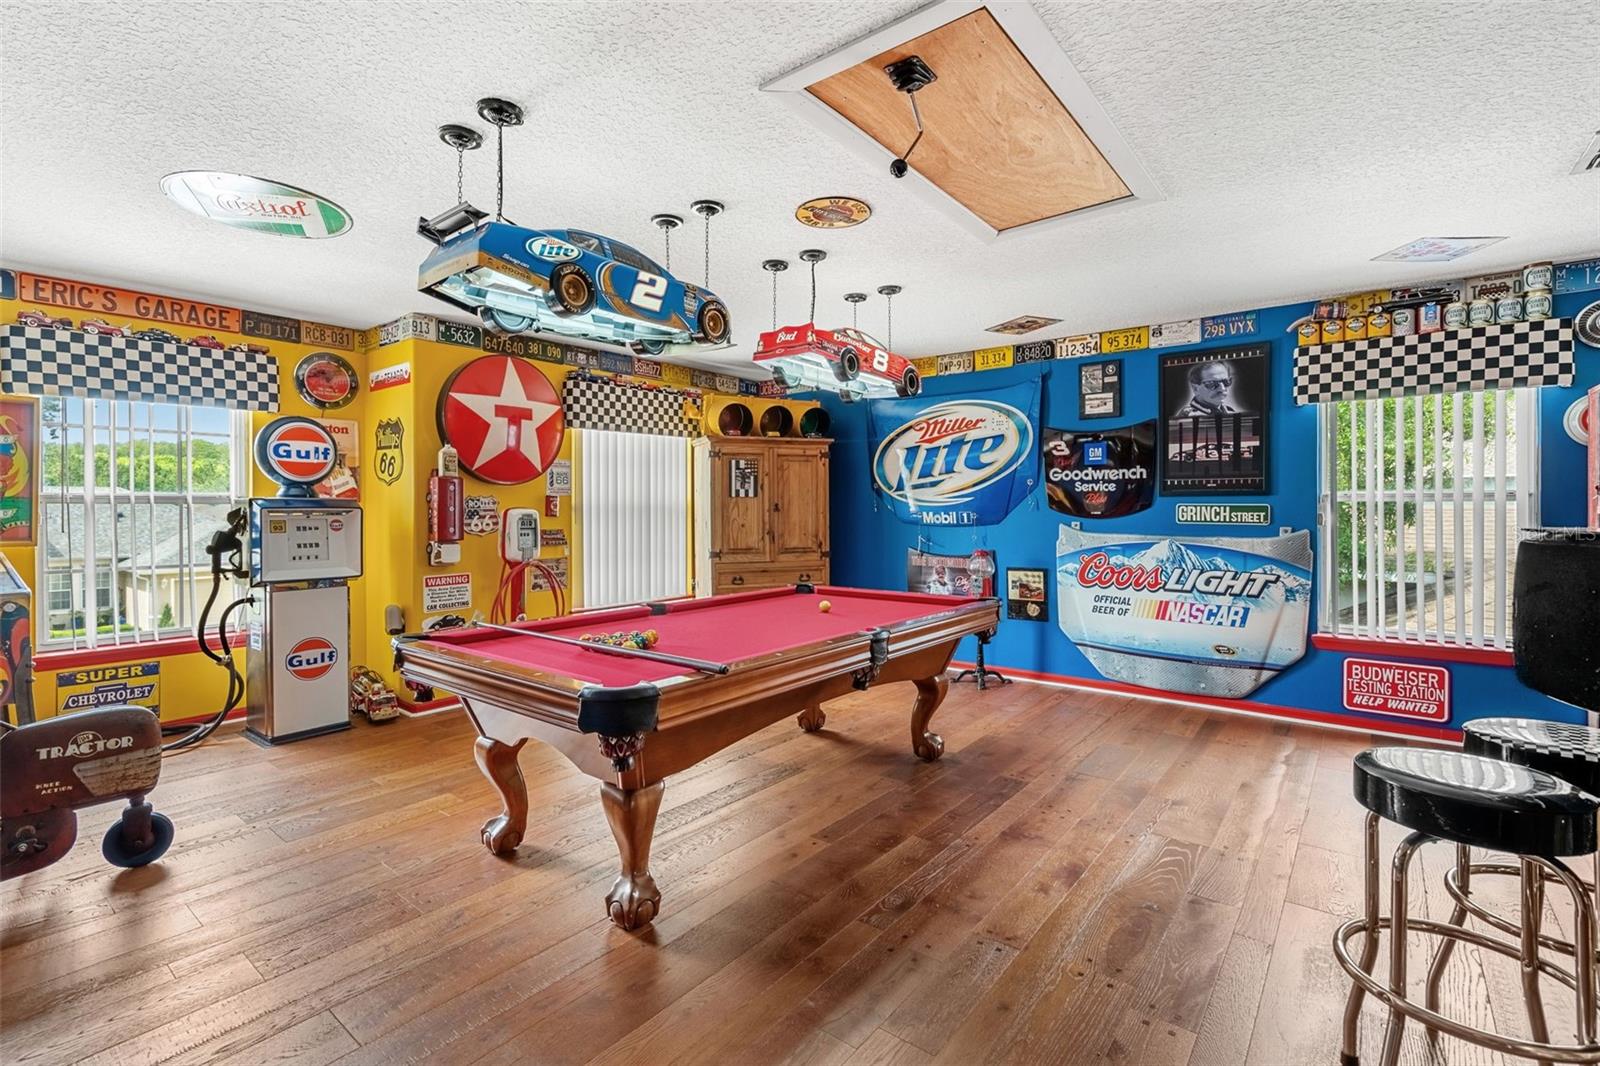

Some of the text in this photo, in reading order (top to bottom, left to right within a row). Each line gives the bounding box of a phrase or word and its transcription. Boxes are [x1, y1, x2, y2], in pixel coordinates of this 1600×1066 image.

[539, 244, 574, 258] Lite
[630, 270, 668, 313] 2
[33, 278, 232, 330] ERIC'S GARAGE
[276, 325, 297, 340] 171
[411, 320, 430, 335] 913
[450, 327, 475, 345] 5632
[1204, 319, 1254, 338] 298 VYX
[776, 330, 798, 343] Bud
[1107, 333, 1142, 347] 95 374
[527, 342, 542, 354] 381
[547, 345, 561, 358] 090
[872, 349, 889, 372] 8
[494, 404, 533, 450] T
[912, 416, 987, 445] Miller
[272, 442, 331, 461] Gulf
[1048, 440, 1071, 456] 3
[1088, 447, 1102, 457] GM
[379, 452, 396, 477] 66
[893, 433, 1005, 491] Lite
[555, 476, 569, 485] 66
[1049, 465, 1147, 482] Goodwrench
[1074, 481, 1117, 492] Service
[1085, 492, 1108, 505] Plus
[923, 512, 957, 524] Mobil
[1178, 505, 1265, 523] GRINCH STREET
[471, 515, 494, 532] 66
[426, 575, 469, 586] WARNING
[1076, 552, 1279, 598] Coors LIGHT
[438, 600, 469, 609] COLLECTING
[1093, 594, 1132, 606] OFFICIAL
[1092, 605, 1130, 617] BEER OF
[1166, 600, 1246, 628] NASCAR
[287, 650, 336, 668] Gulf
[75, 665, 144, 684] SUPER
[1351, 664, 1439, 688] BUDWEISER
[68, 686, 151, 708] CHEVROLET
[1347, 678, 1445, 702] TESTING STATION
[1353, 694, 1438, 714] HELP WANTED
[36, 735, 134, 760] TRACTOR
[35, 781, 61, 790] KNEE
[41, 785, 73, 795] ACTION
